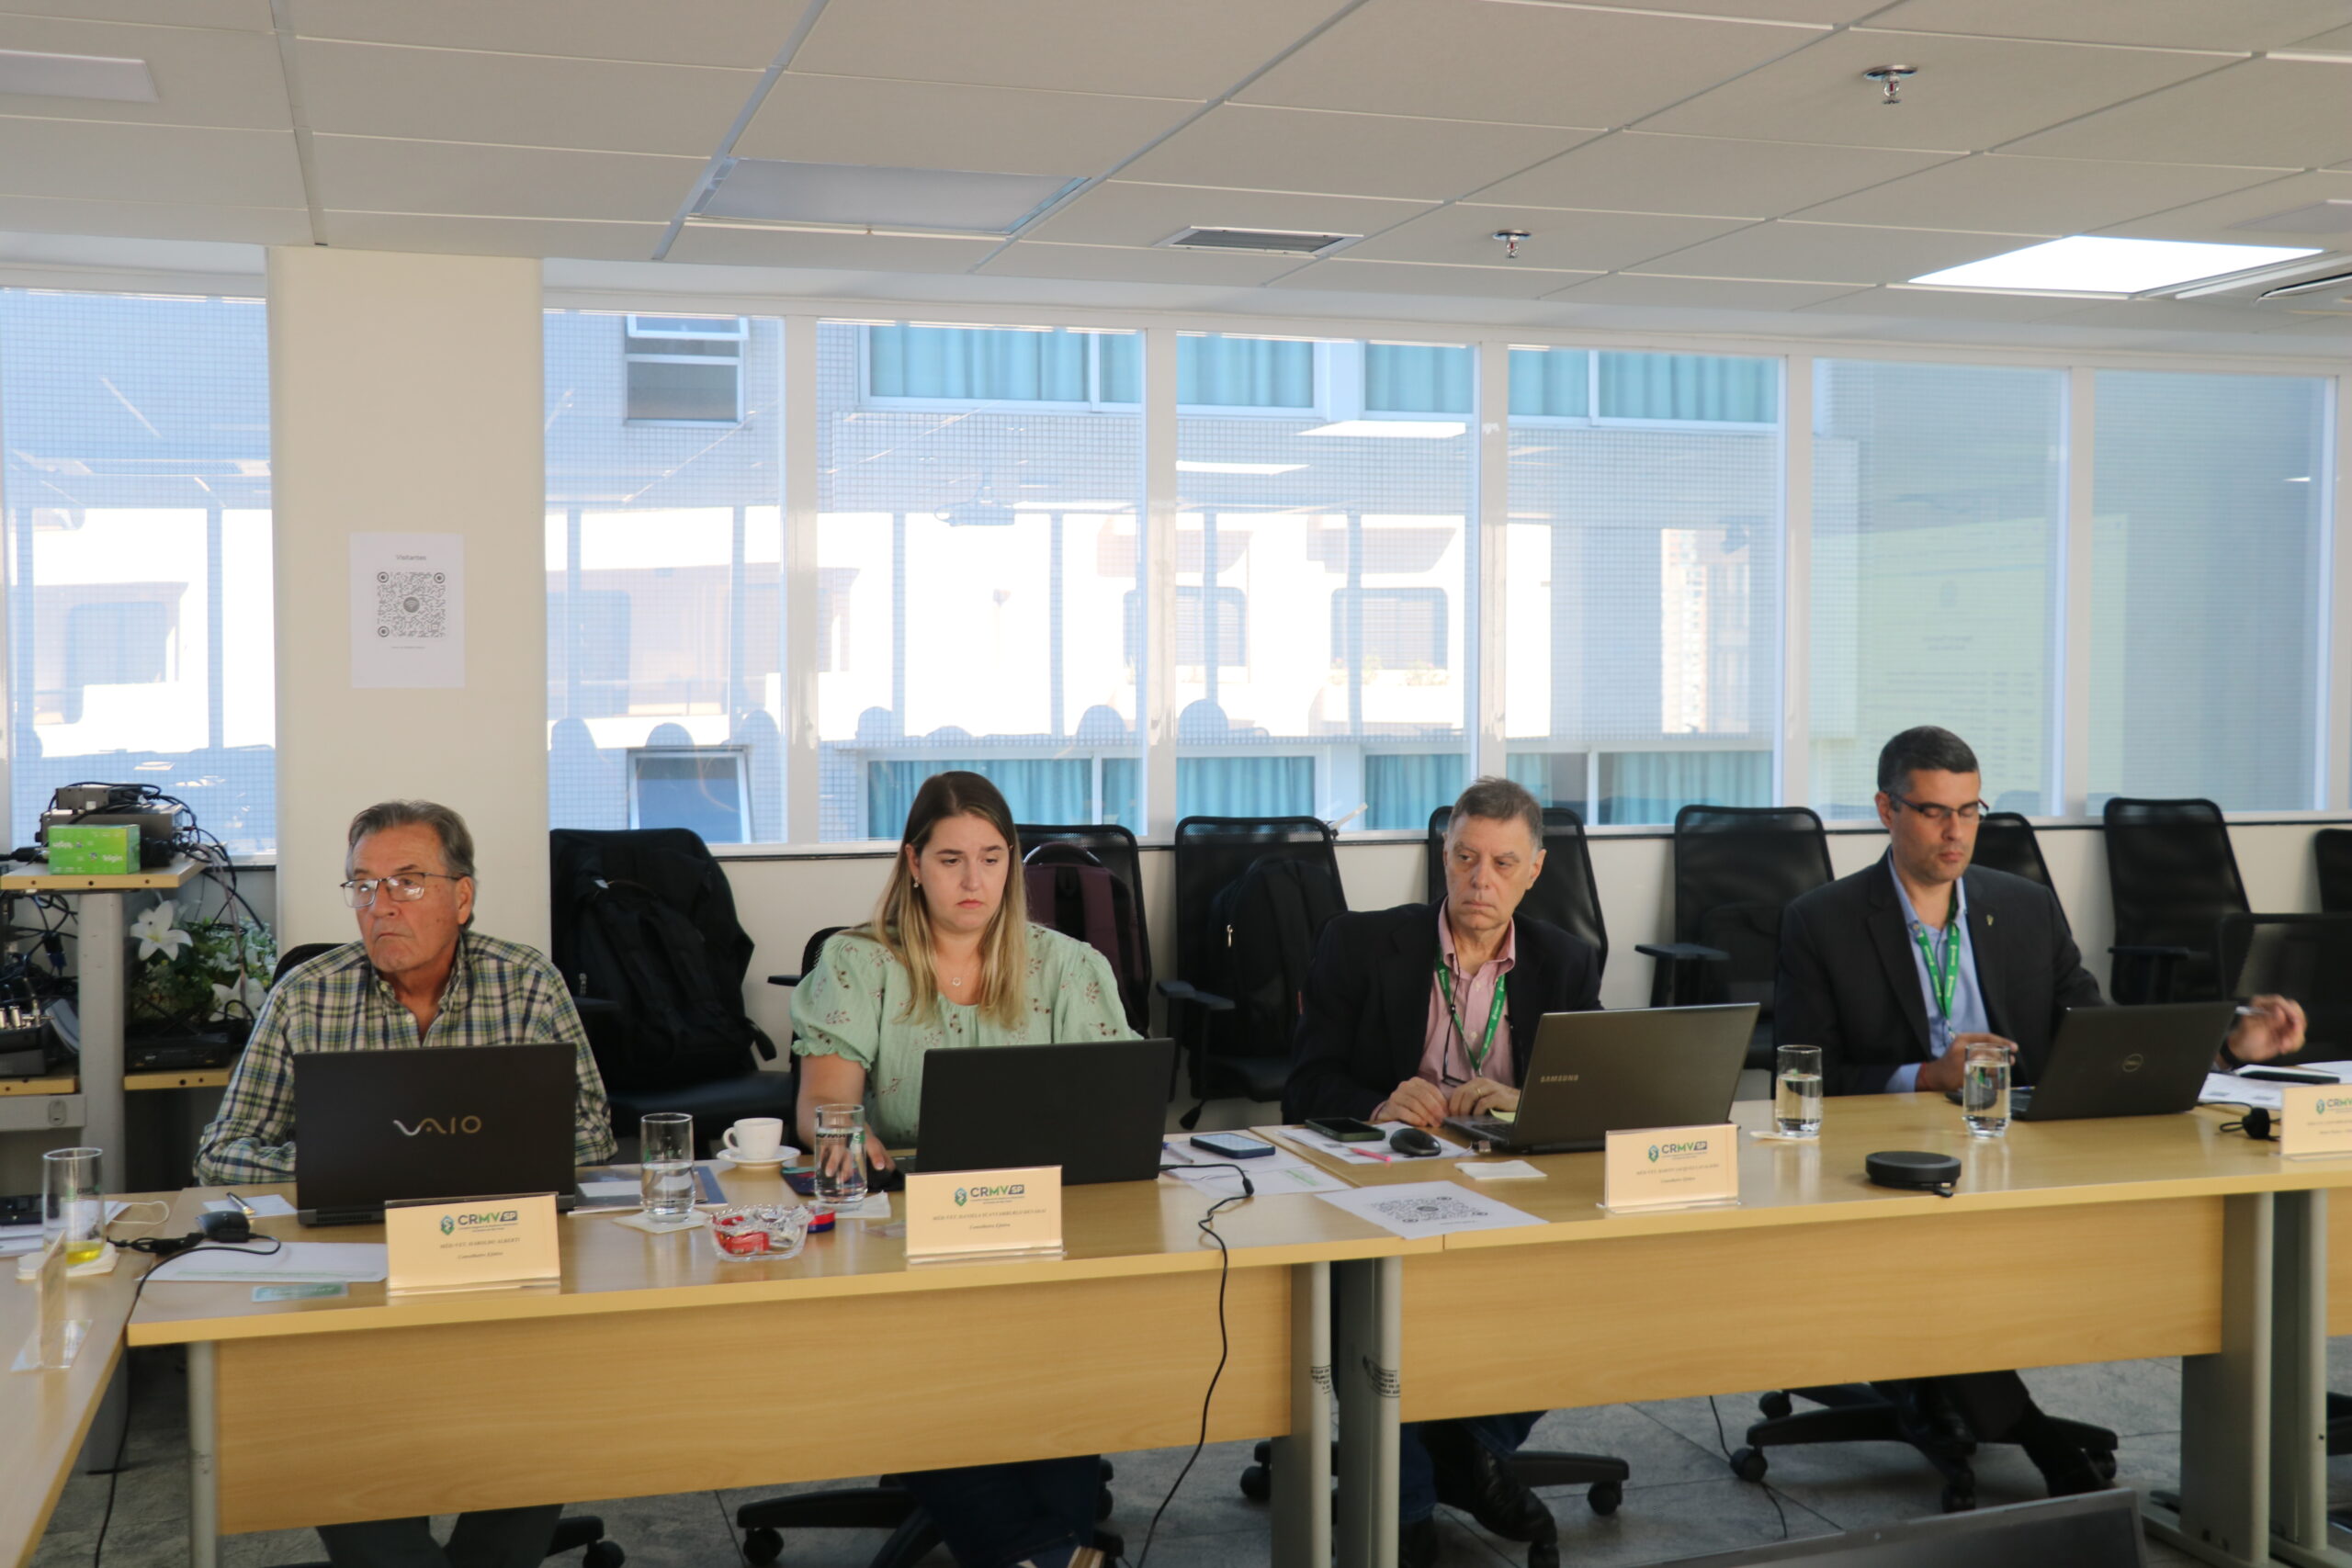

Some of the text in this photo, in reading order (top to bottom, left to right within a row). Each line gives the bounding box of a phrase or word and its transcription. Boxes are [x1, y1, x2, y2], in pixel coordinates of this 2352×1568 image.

[1540, 1074, 1579, 1083] SAMSUNG
[393, 1115, 481, 1136] VAIO
[1661, 1142, 1693, 1154] CRMV
[970, 1185, 1010, 1197] CRMV
[458, 1212, 517, 1225] CRMV SP
